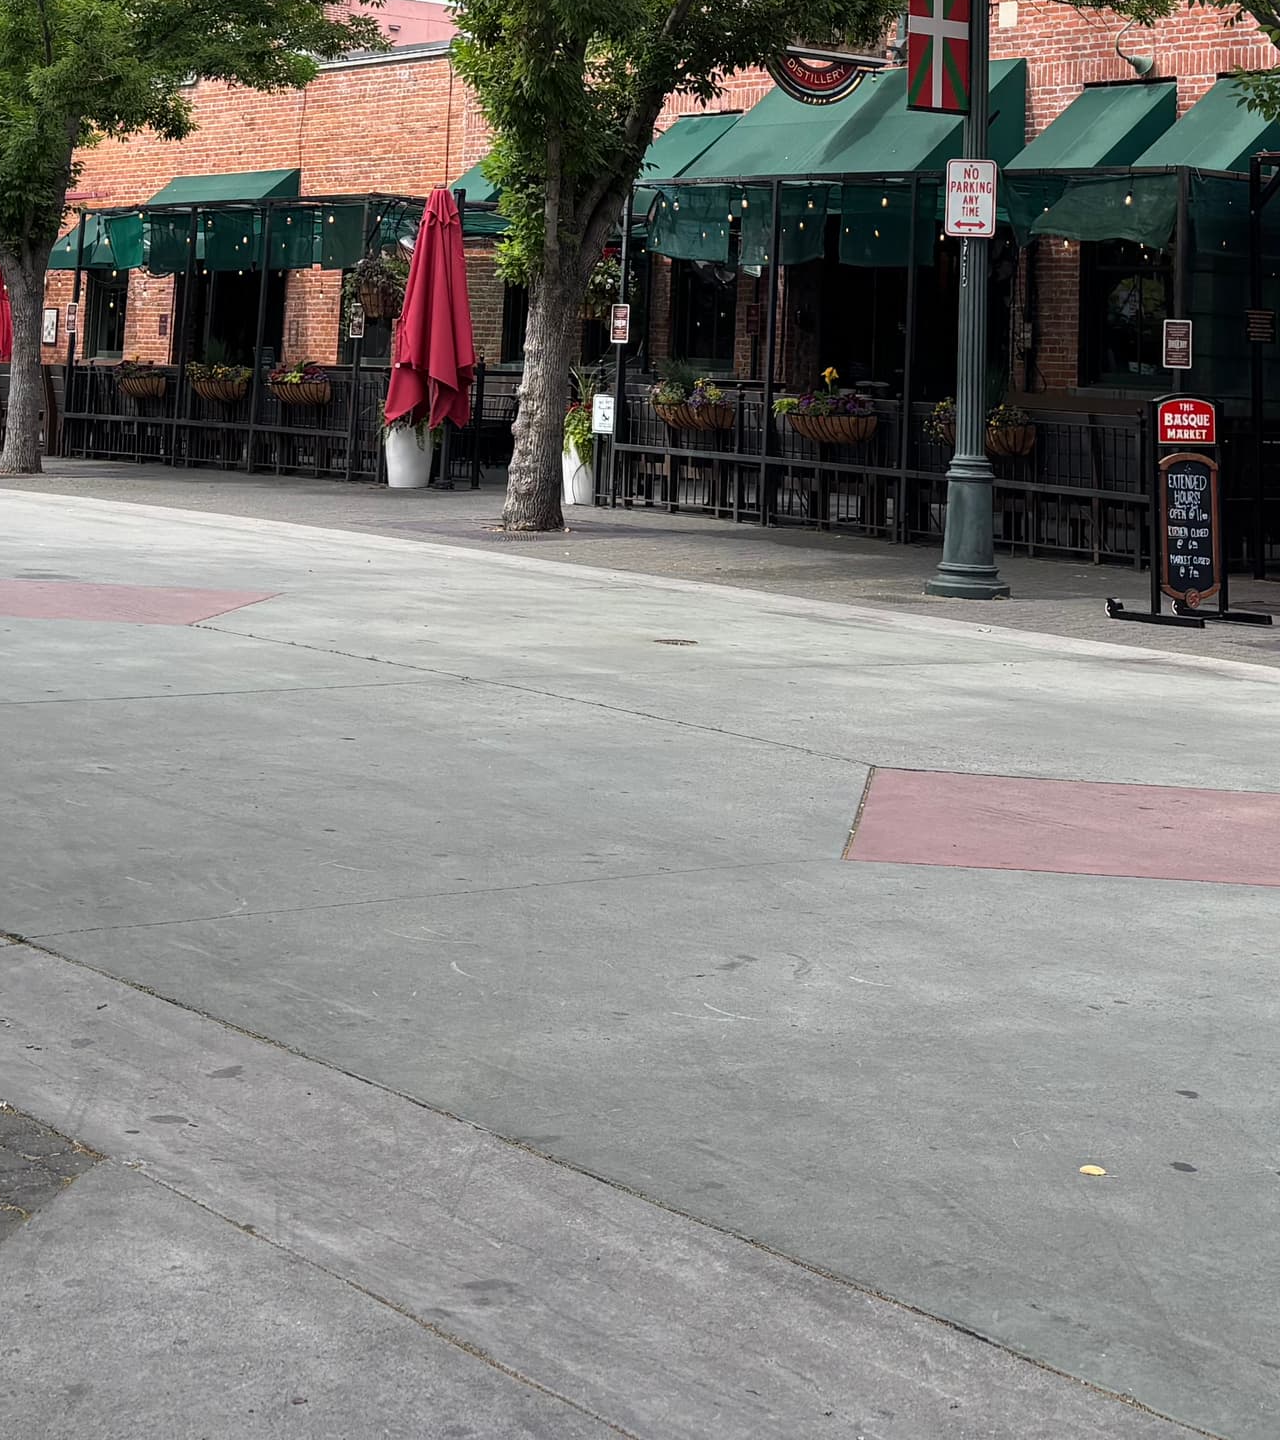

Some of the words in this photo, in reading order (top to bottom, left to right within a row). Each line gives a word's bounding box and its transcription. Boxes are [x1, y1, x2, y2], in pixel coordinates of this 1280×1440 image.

[786, 57, 846, 84] DISTILLERY
[963, 167, 980, 180] NO
[950, 181, 992, 193] PARKING
[962, 195, 980, 205] ANY
[962, 206, 980, 217] TIME
[1179, 402, 1195, 411] THE
[1163, 412, 1210, 428] BASQUE
[1166, 428, 1207, 440] MARKET
[1167, 473, 1207, 491] EXTENDED
[1169, 508, 1187, 520] OPEN
